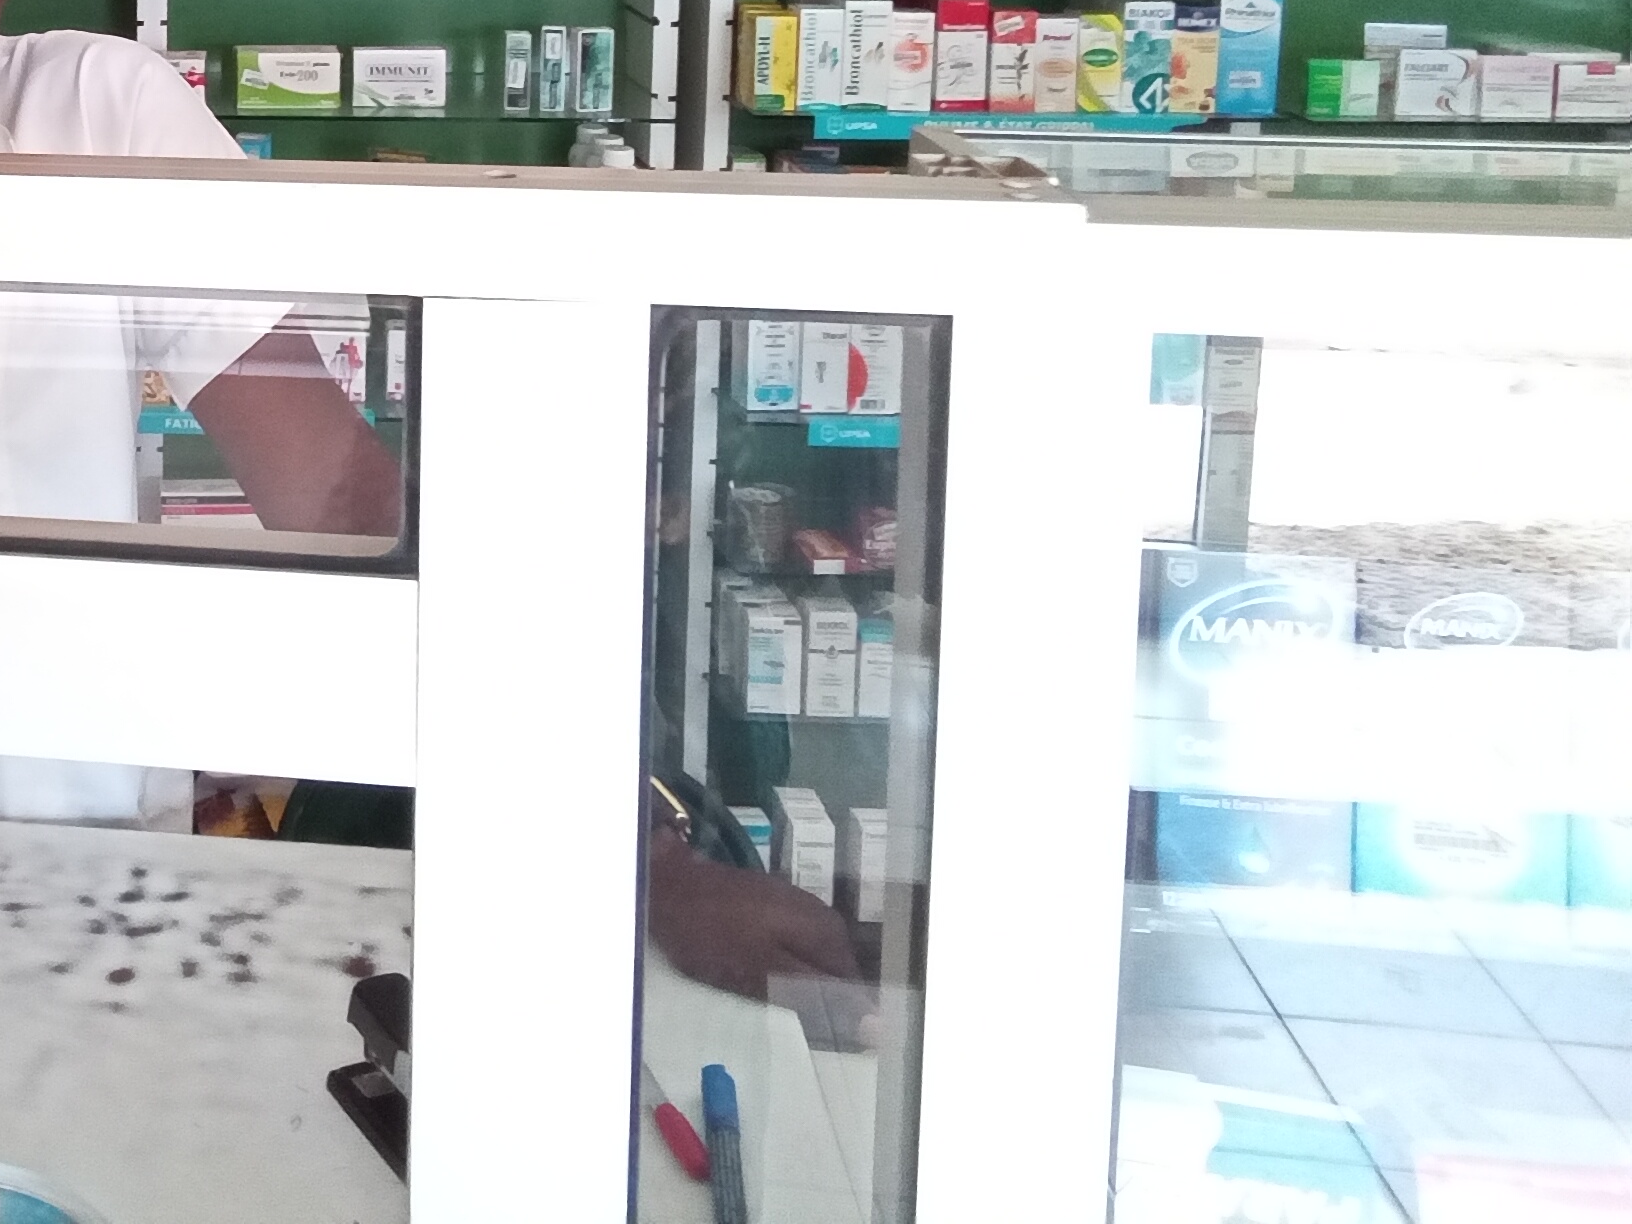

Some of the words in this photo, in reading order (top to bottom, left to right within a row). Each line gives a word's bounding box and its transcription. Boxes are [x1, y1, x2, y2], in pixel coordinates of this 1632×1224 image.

[164, 418, 202, 431] FATI
[1188, 615, 1324, 644] MANIX
[1419, 617, 1501, 640] MANIX
